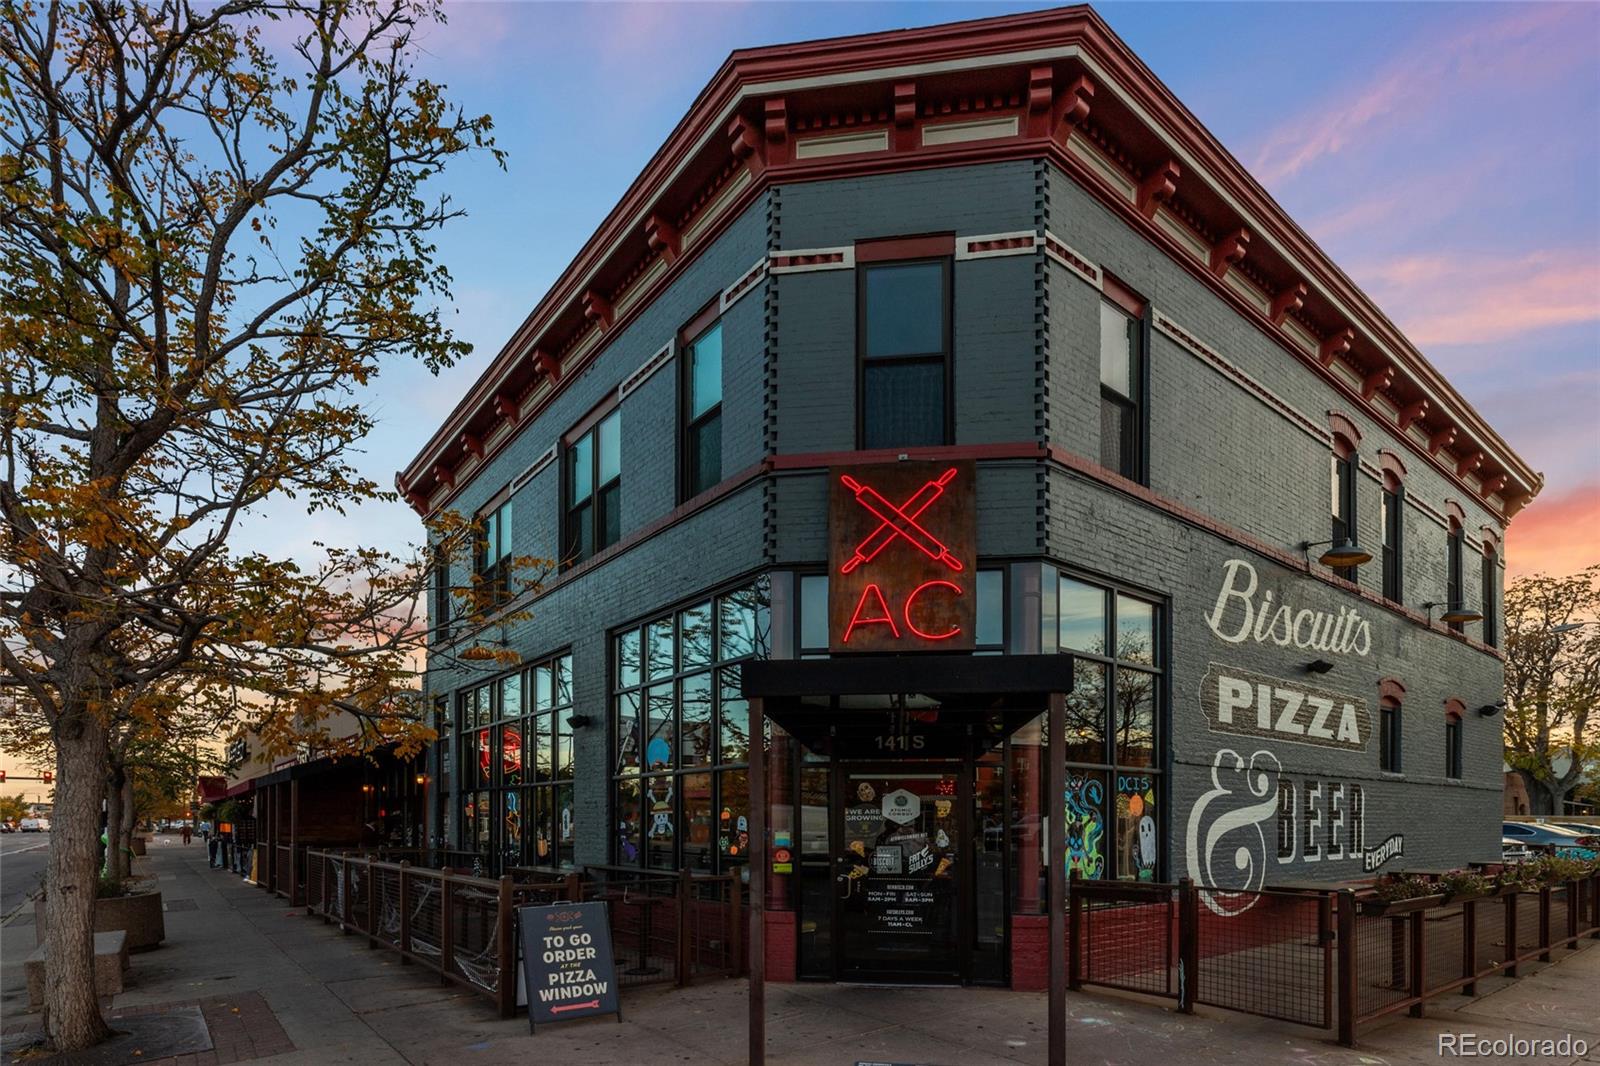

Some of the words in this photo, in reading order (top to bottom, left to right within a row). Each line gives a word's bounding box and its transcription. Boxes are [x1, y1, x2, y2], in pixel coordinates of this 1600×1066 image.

[844, 580, 962, 642] AC
[1204, 559, 1372, 657] Biscuits
[1217, 674, 1361, 744] PIZZA
[1186, 749, 1283, 917] &
[1277, 777, 1365, 864] BEER
[908, 851, 921, 865] FAT
[1365, 835, 1403, 871] EVERYDAY
[542, 947, 597, 963] ORDER
[543, 935, 565, 949] TO
[569, 933, 592, 946] GO
[548, 969, 597, 985] PIZZA
[539, 981, 608, 1002] WINDOW
